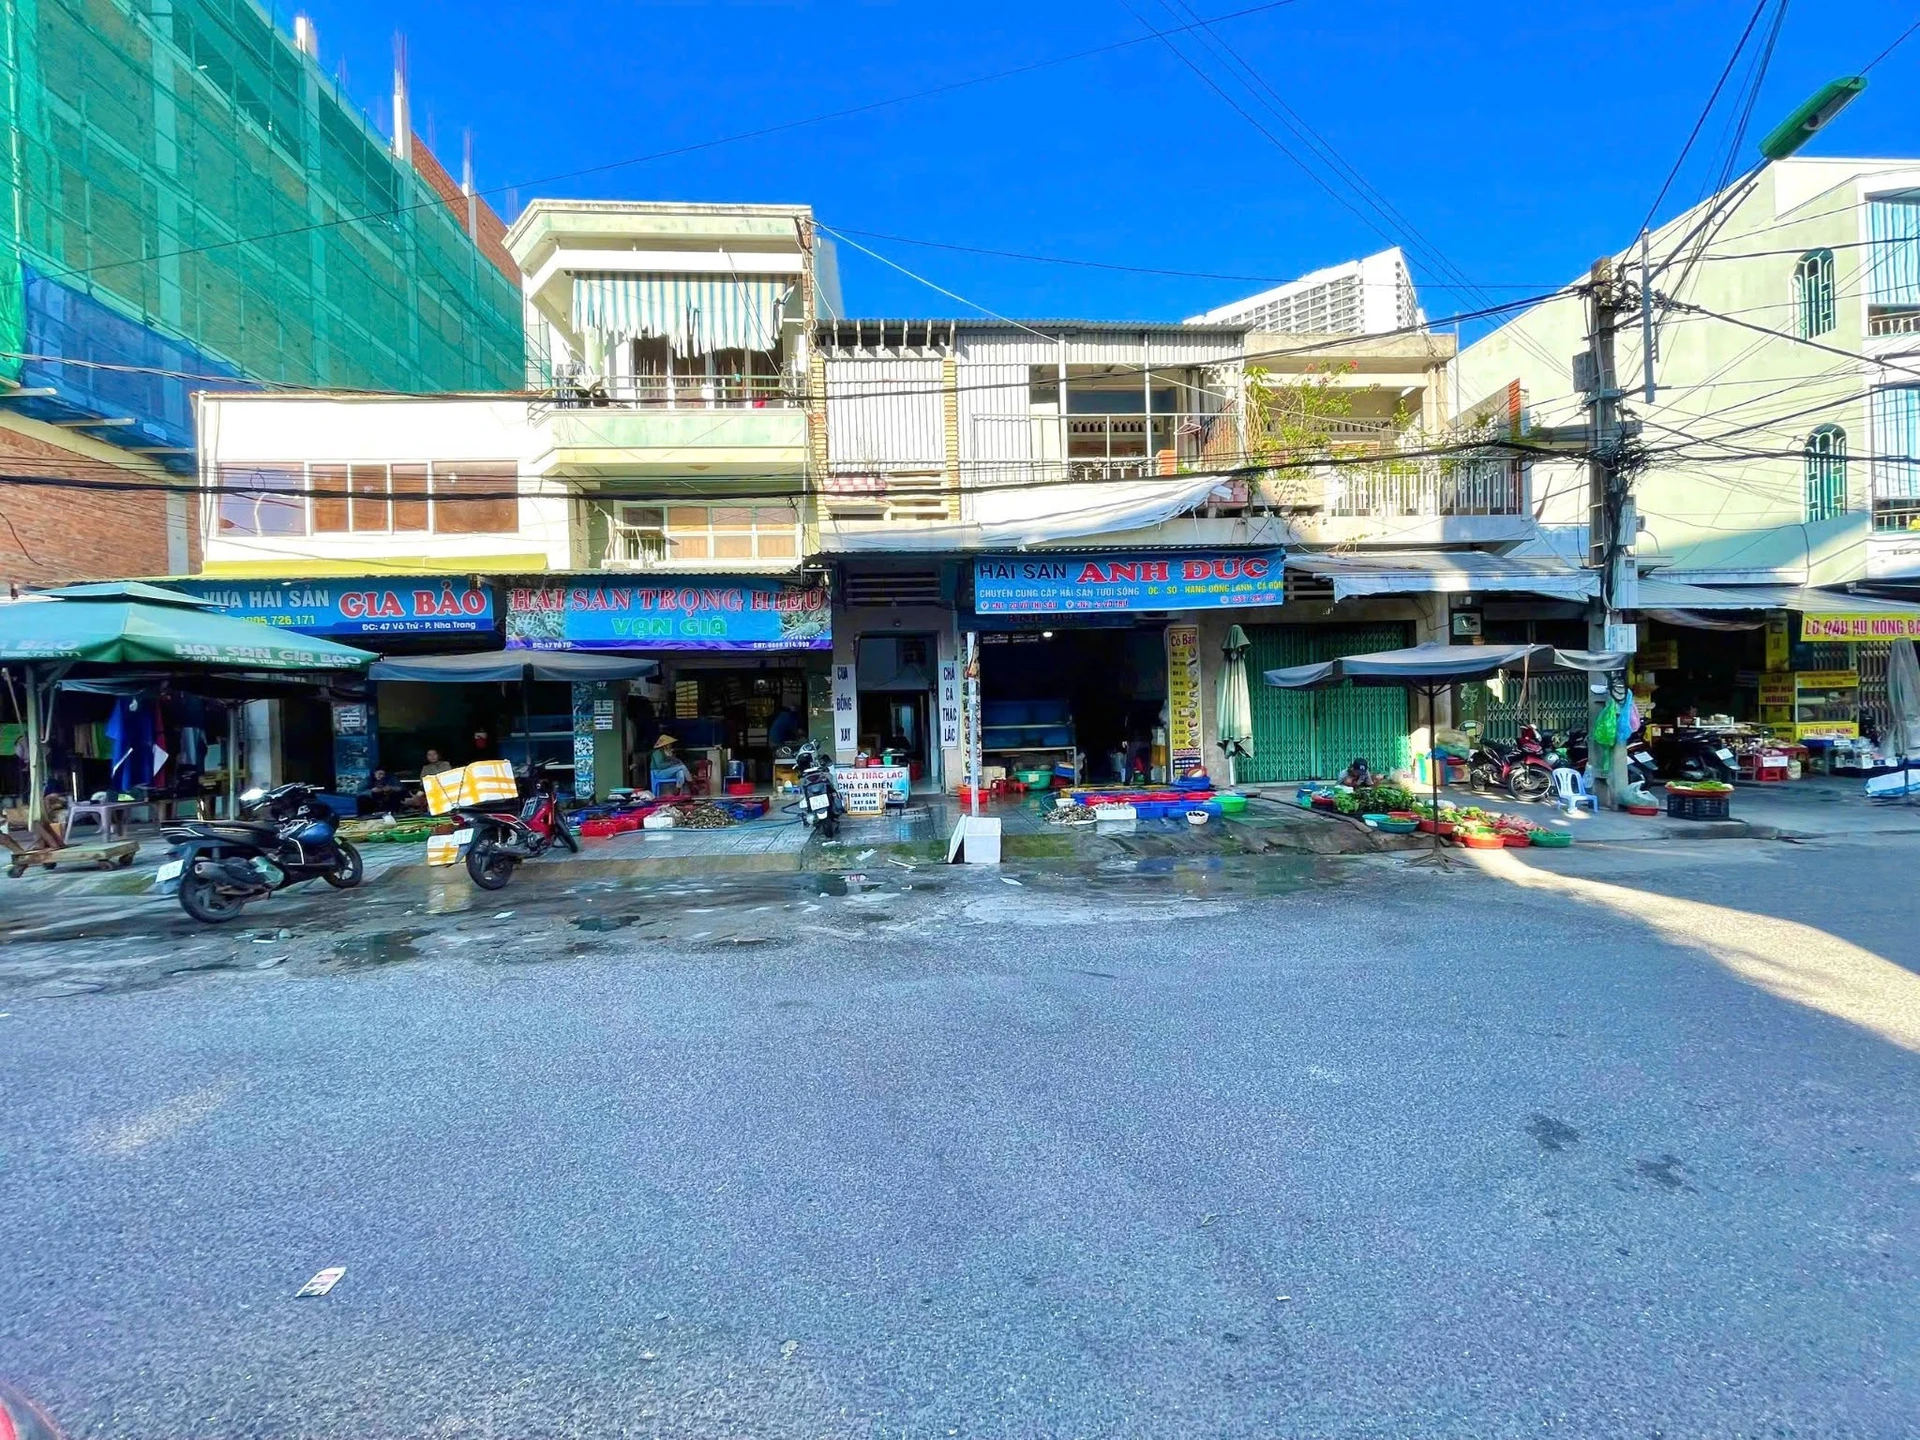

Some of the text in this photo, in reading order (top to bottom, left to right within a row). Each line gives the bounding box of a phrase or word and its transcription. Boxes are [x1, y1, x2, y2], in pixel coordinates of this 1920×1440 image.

[1076, 561, 1169, 584] ANH
[248, 585, 283, 608] HẢI
[289, 584, 330, 607] SẢN
[338, 579, 488, 618] GIA BẢO
[638, 587, 744, 617] TRỌNG
[1015, 588, 1039, 598] CUNG
[434, 621, 450, 629] Nha
[453, 621, 477, 630] Trang
[612, 617, 673, 639] VẠN
[840, 728, 851, 742] XAY
